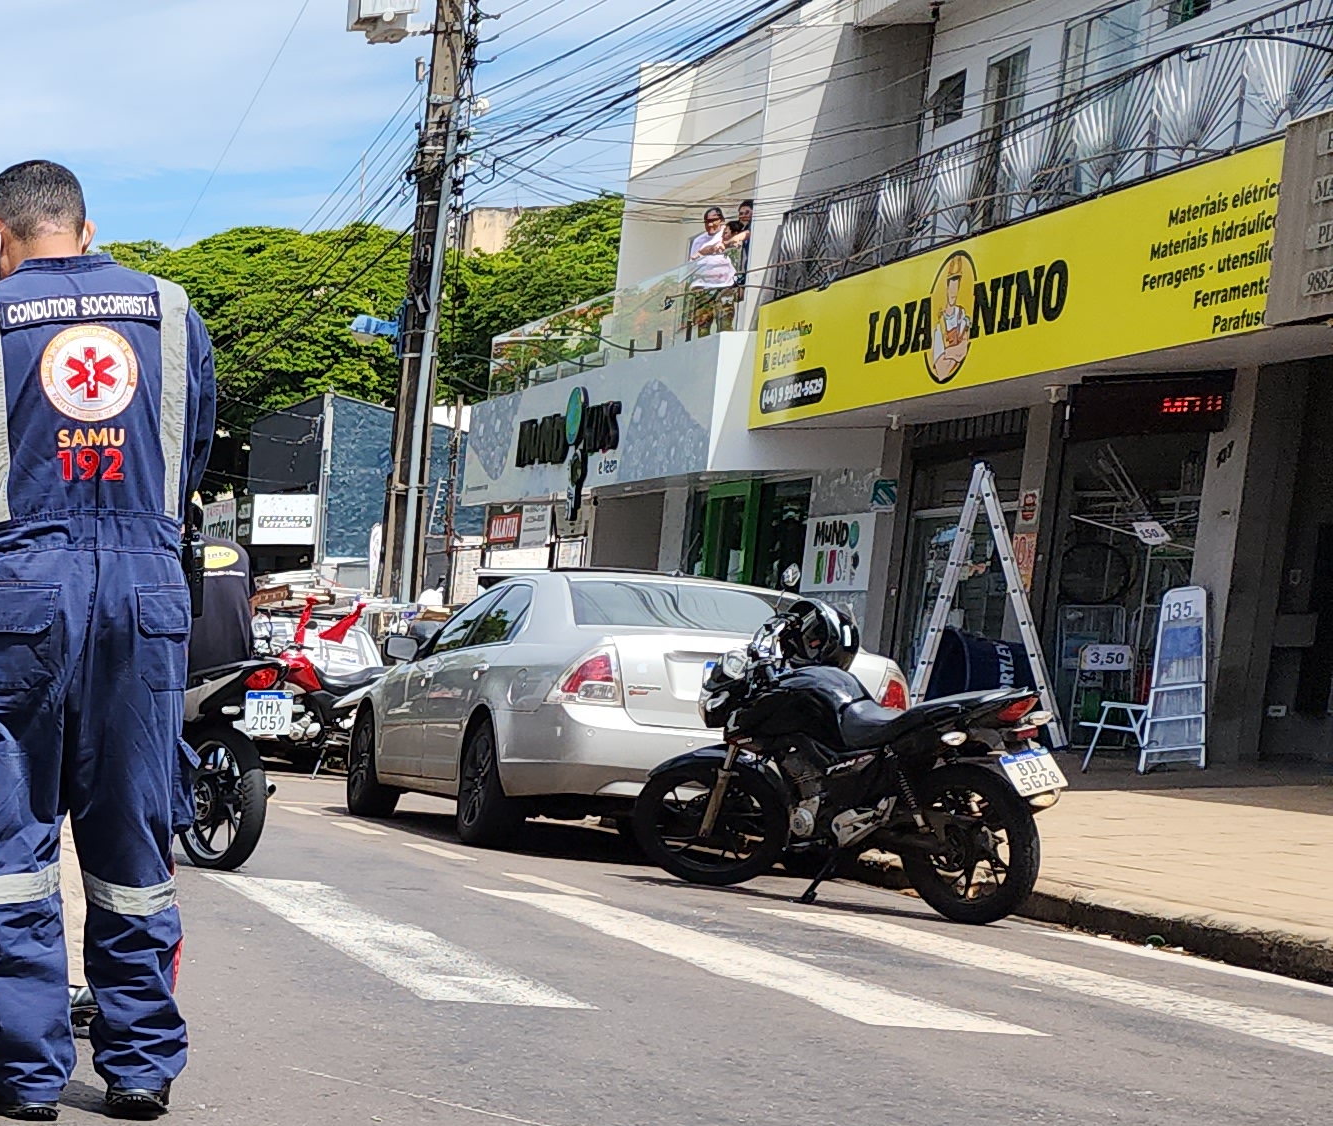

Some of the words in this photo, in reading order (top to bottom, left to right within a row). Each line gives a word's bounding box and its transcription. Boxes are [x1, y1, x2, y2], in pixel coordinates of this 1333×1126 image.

[1167, 192, 1229, 228] Materiais
[1149, 227, 1208, 262] Materiais
[1141, 262, 1206, 293] Ferragens
[7, 297, 78, 325] CONDUTOR
[81, 295, 158, 319] SOCORRISTA
[863, 297, 933, 364] LOJA
[968, 259, 1069, 340] NINO
[57, 427, 125, 448] SAMU
[57, 447, 125, 482] 192
[1164, 600, 1194, 623] 135
[251, 715, 286, 731] 2C59
[256, 700, 283, 716] RHX
[1020, 770, 1060, 792] 5G28
